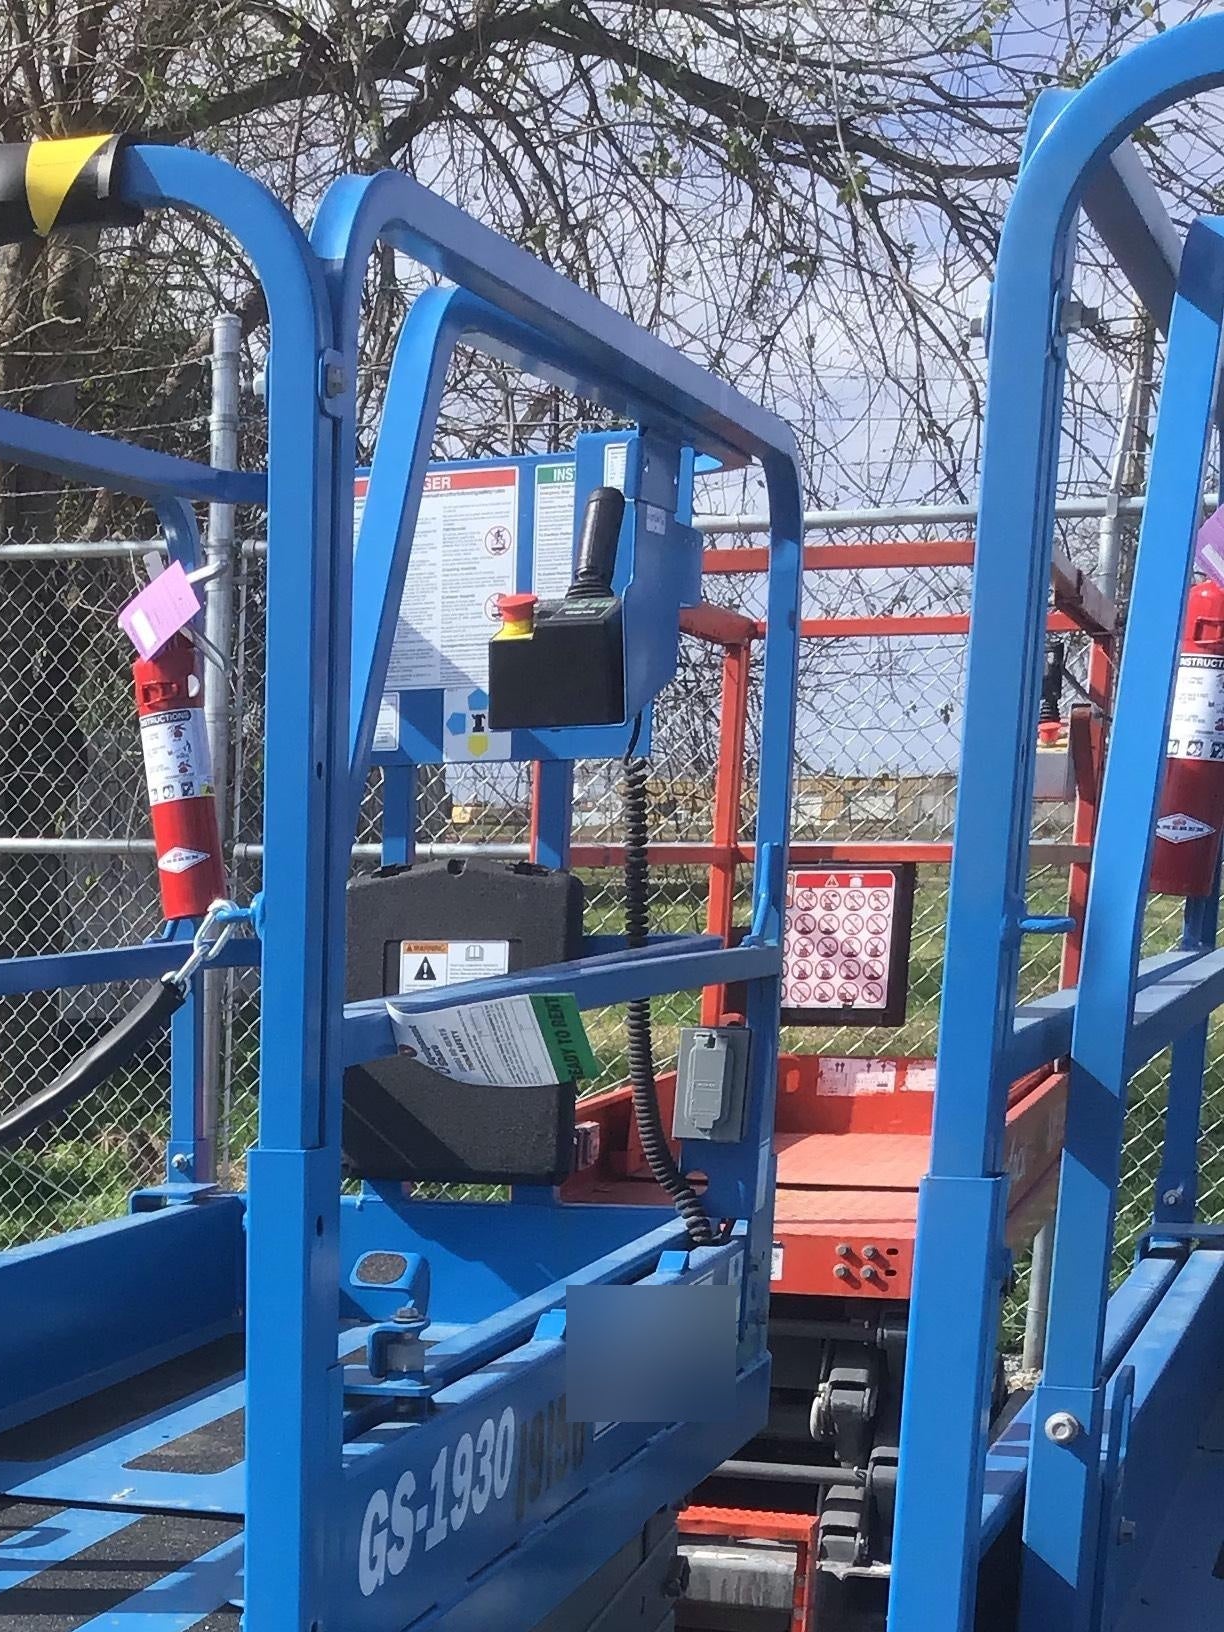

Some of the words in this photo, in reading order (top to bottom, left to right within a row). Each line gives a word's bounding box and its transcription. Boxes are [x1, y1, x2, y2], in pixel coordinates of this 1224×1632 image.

[424, 477, 451, 489] GER
[544, 997, 567, 1027] RENT
[555, 1030, 573, 1045] TO
[359, 1406, 514, 1597] GS-1930
